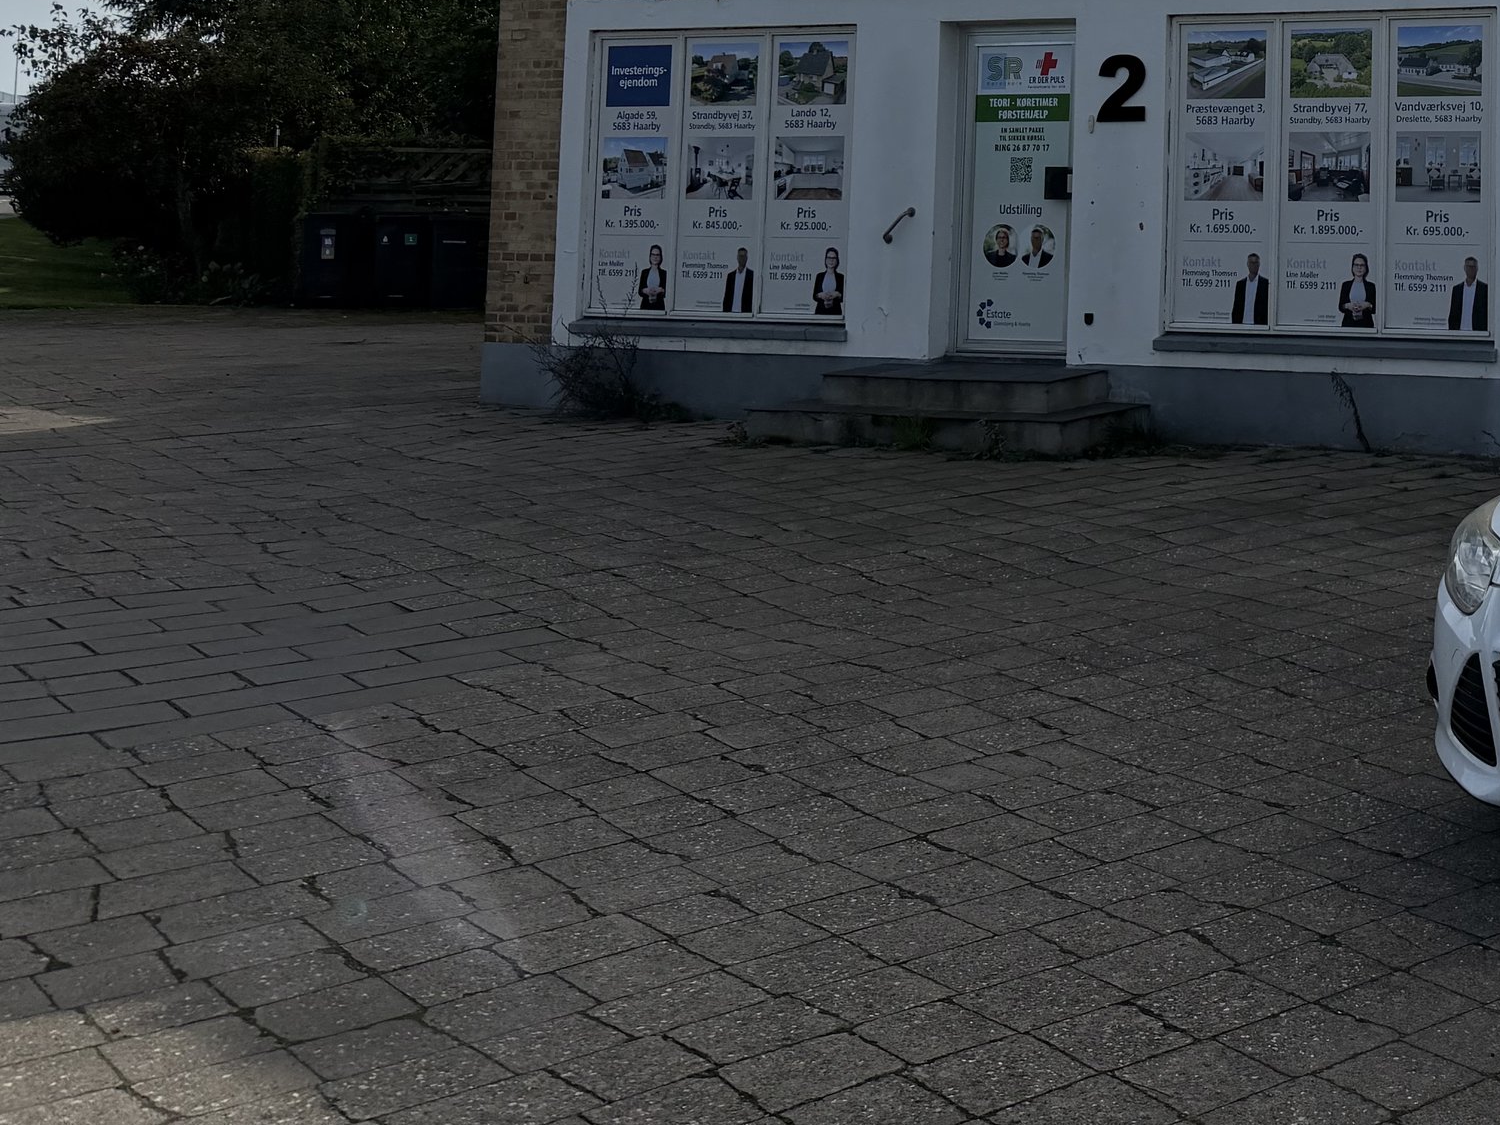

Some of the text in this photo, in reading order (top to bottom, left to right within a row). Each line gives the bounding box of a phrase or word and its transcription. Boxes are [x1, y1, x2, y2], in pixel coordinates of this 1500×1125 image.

[612, 65, 667, 77] Investerings-
[988, 56, 1023, 81] SR
[619, 77, 658, 88] ejendom
[1097, 54, 1146, 122] 2
[990, 99, 1010, 107] TEORI
[1017, 98, 1058, 107] KØRETIMER
[1395, 101, 1484, 114] Vandværksvej 10,
[791, 108, 831, 119] Landø 12,
[998, 110, 1048, 119] FØRSTEHJÆLP
[1186, 103, 1265, 115] Præstevænget 3,
[1293, 103, 1368, 115] Strandbyvej 77,
[617, 111, 657, 121] Algade 59,
[692, 110, 753, 122] Strandbyvej 37,
[1196, 115, 1255, 127] 5683 Haarby
[1289, 116, 1370, 125] Strandby, 5683 Haarby
[1396, 115, 1482, 124] Dreslette, 5683 Haarby
[613, 122, 661, 132] 5683 Haarby
[785, 119, 836, 130] 5683 Haarby
[624, 205, 642, 217] Pris
[709, 207, 727, 218] Pris
[797, 207, 816, 219] Pris
[1000, 204, 1042, 217] Udstilling
[1212, 208, 1234, 221] Pris
[1317, 209, 1340, 222] Pris
[1426, 210, 1449, 223] Pris
[605, 219, 659, 229] Kr. 1.395.000,-
[693, 220, 742, 231] Kr. 845.000,-
[780, 221, 832, 231] Kr. 925.000,-
[1190, 223, 1256, 235] Kr. 1.695.000,-
[1293, 224, 1363, 236] Kr. 1.895.000,-
[1406, 225, 1469, 237] Kr. 695.000,-
[1182, 278, 1230, 288] Tlf. 6599 2111
[1286, 280, 1337, 290] Tlf. 6599 2111
[1394, 283, 1447, 292] Tlf. 6599 2111
